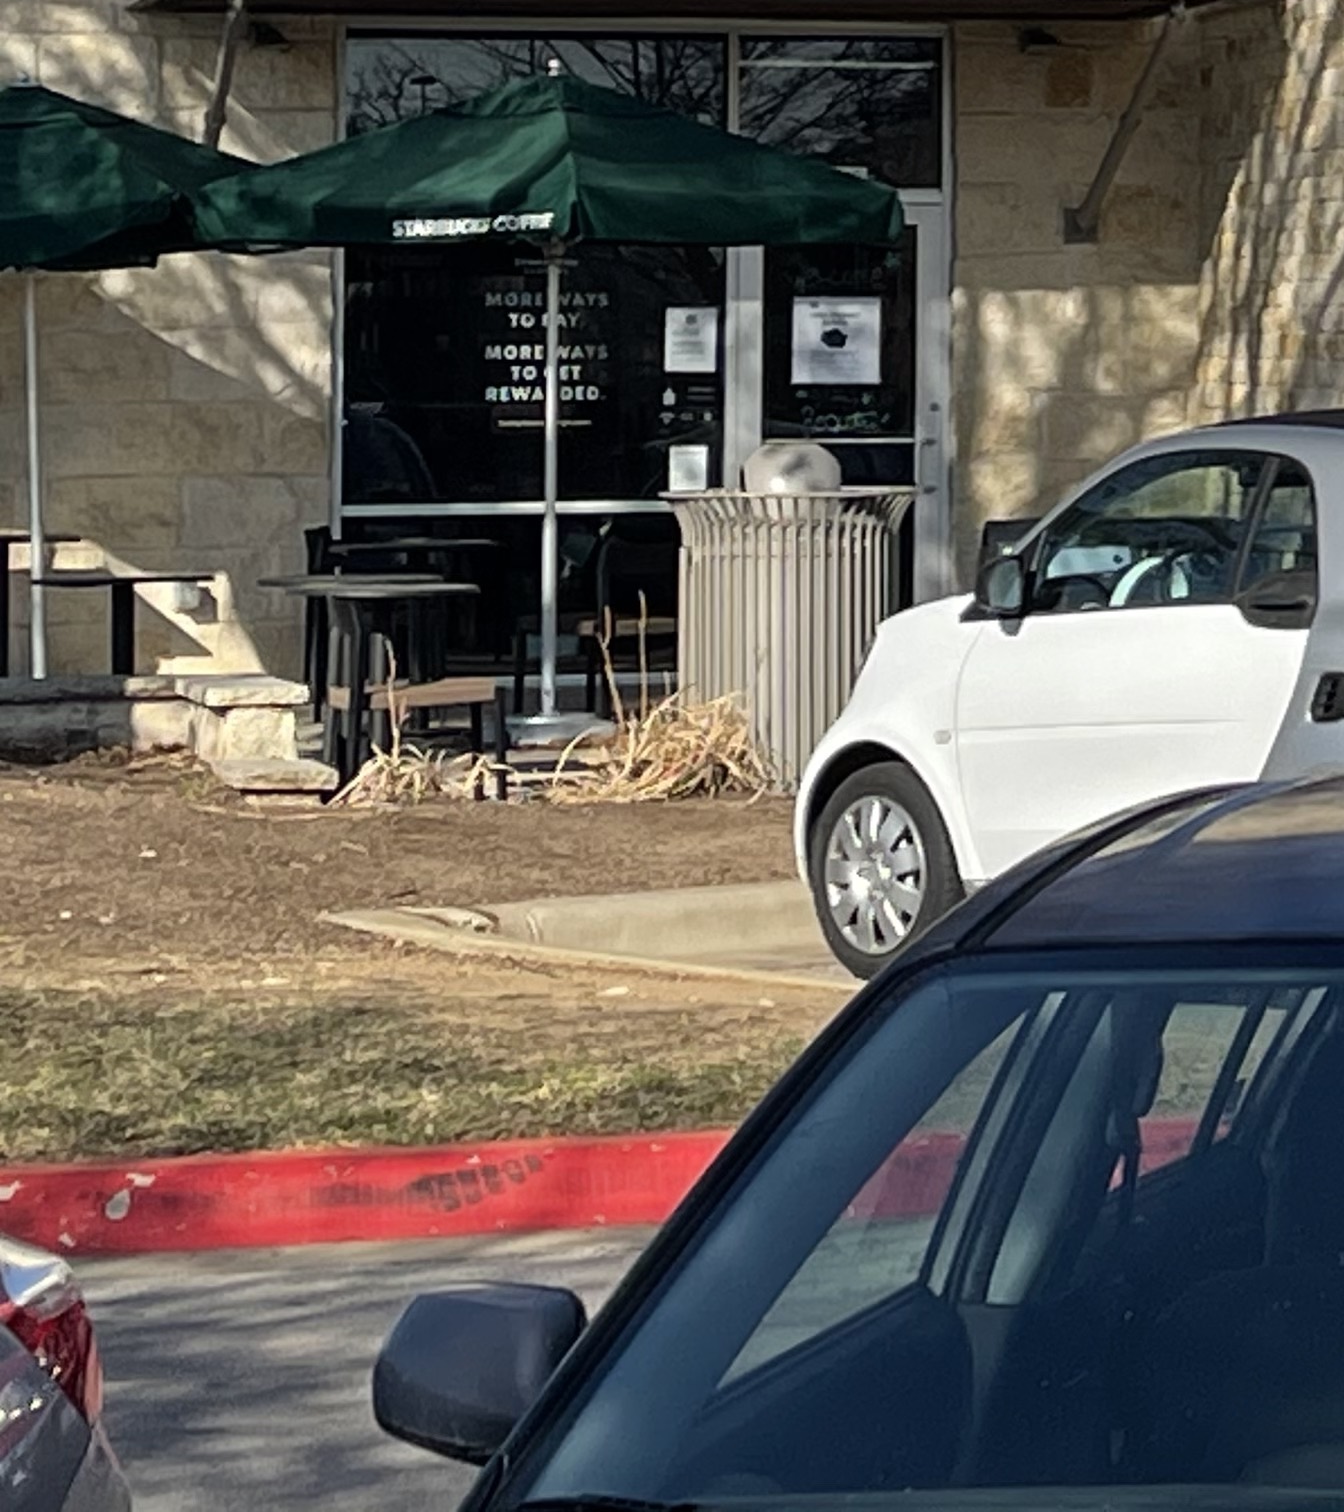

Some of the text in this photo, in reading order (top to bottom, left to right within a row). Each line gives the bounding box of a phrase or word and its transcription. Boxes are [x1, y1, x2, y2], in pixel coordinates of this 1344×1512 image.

[484, 291, 543, 307] MORE
[507, 311, 536, 328] TO
[484, 344, 545, 360] MORE
[510, 365, 538, 381] TO
